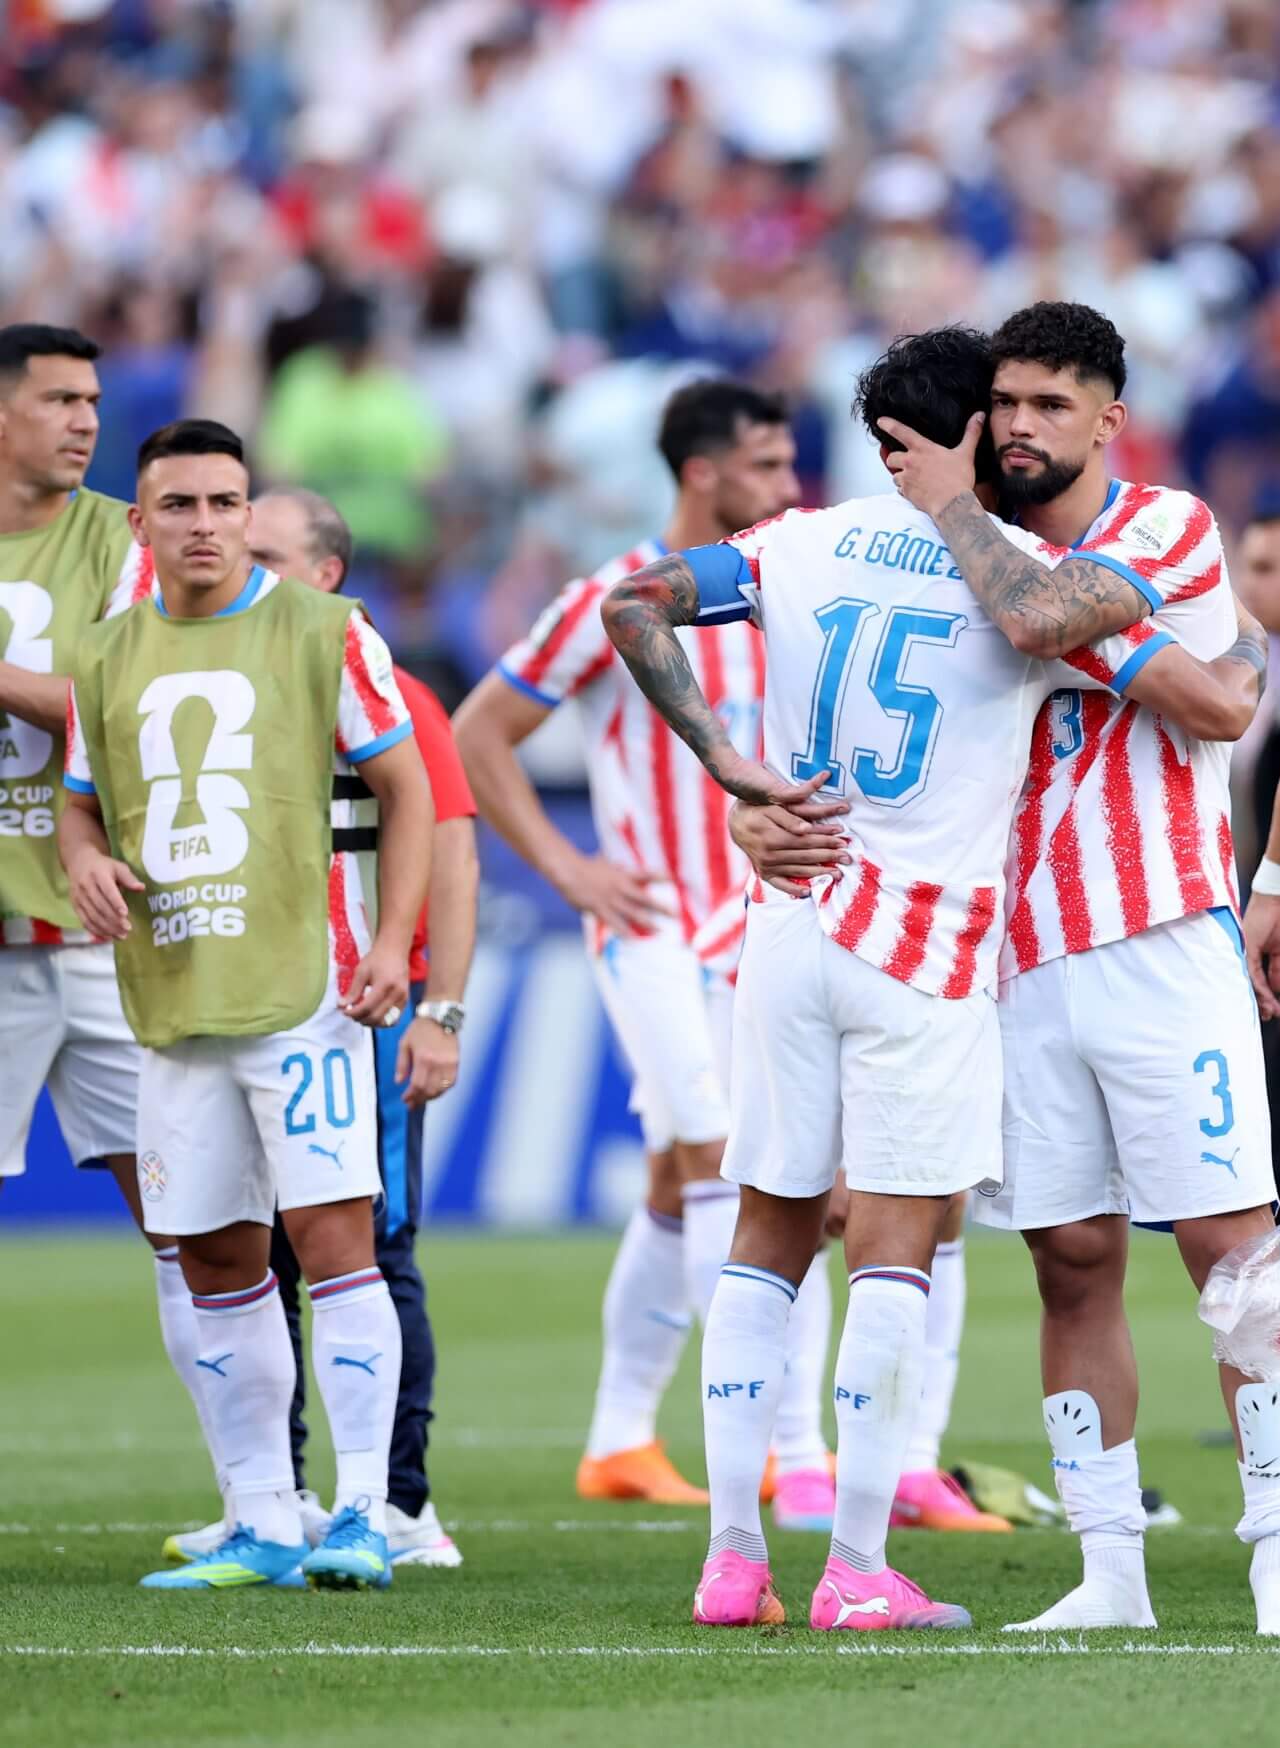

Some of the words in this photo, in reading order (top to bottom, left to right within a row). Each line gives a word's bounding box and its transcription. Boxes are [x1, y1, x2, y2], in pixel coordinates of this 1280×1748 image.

[834, 527, 862, 559] G.
[791, 597, 969, 808] 15
[1051, 688, 1085, 761] 3
[12, 785, 54, 805] CUP
[169, 836, 212, 862] FIFA
[148, 886, 197, 912] WORLD
[200, 883, 248, 903] CUP
[152, 906, 246, 947] 2026
[281, 1048, 355, 1136] 20
[1193, 1048, 1234, 1138] 3
[707, 1380, 765, 1399] APF
